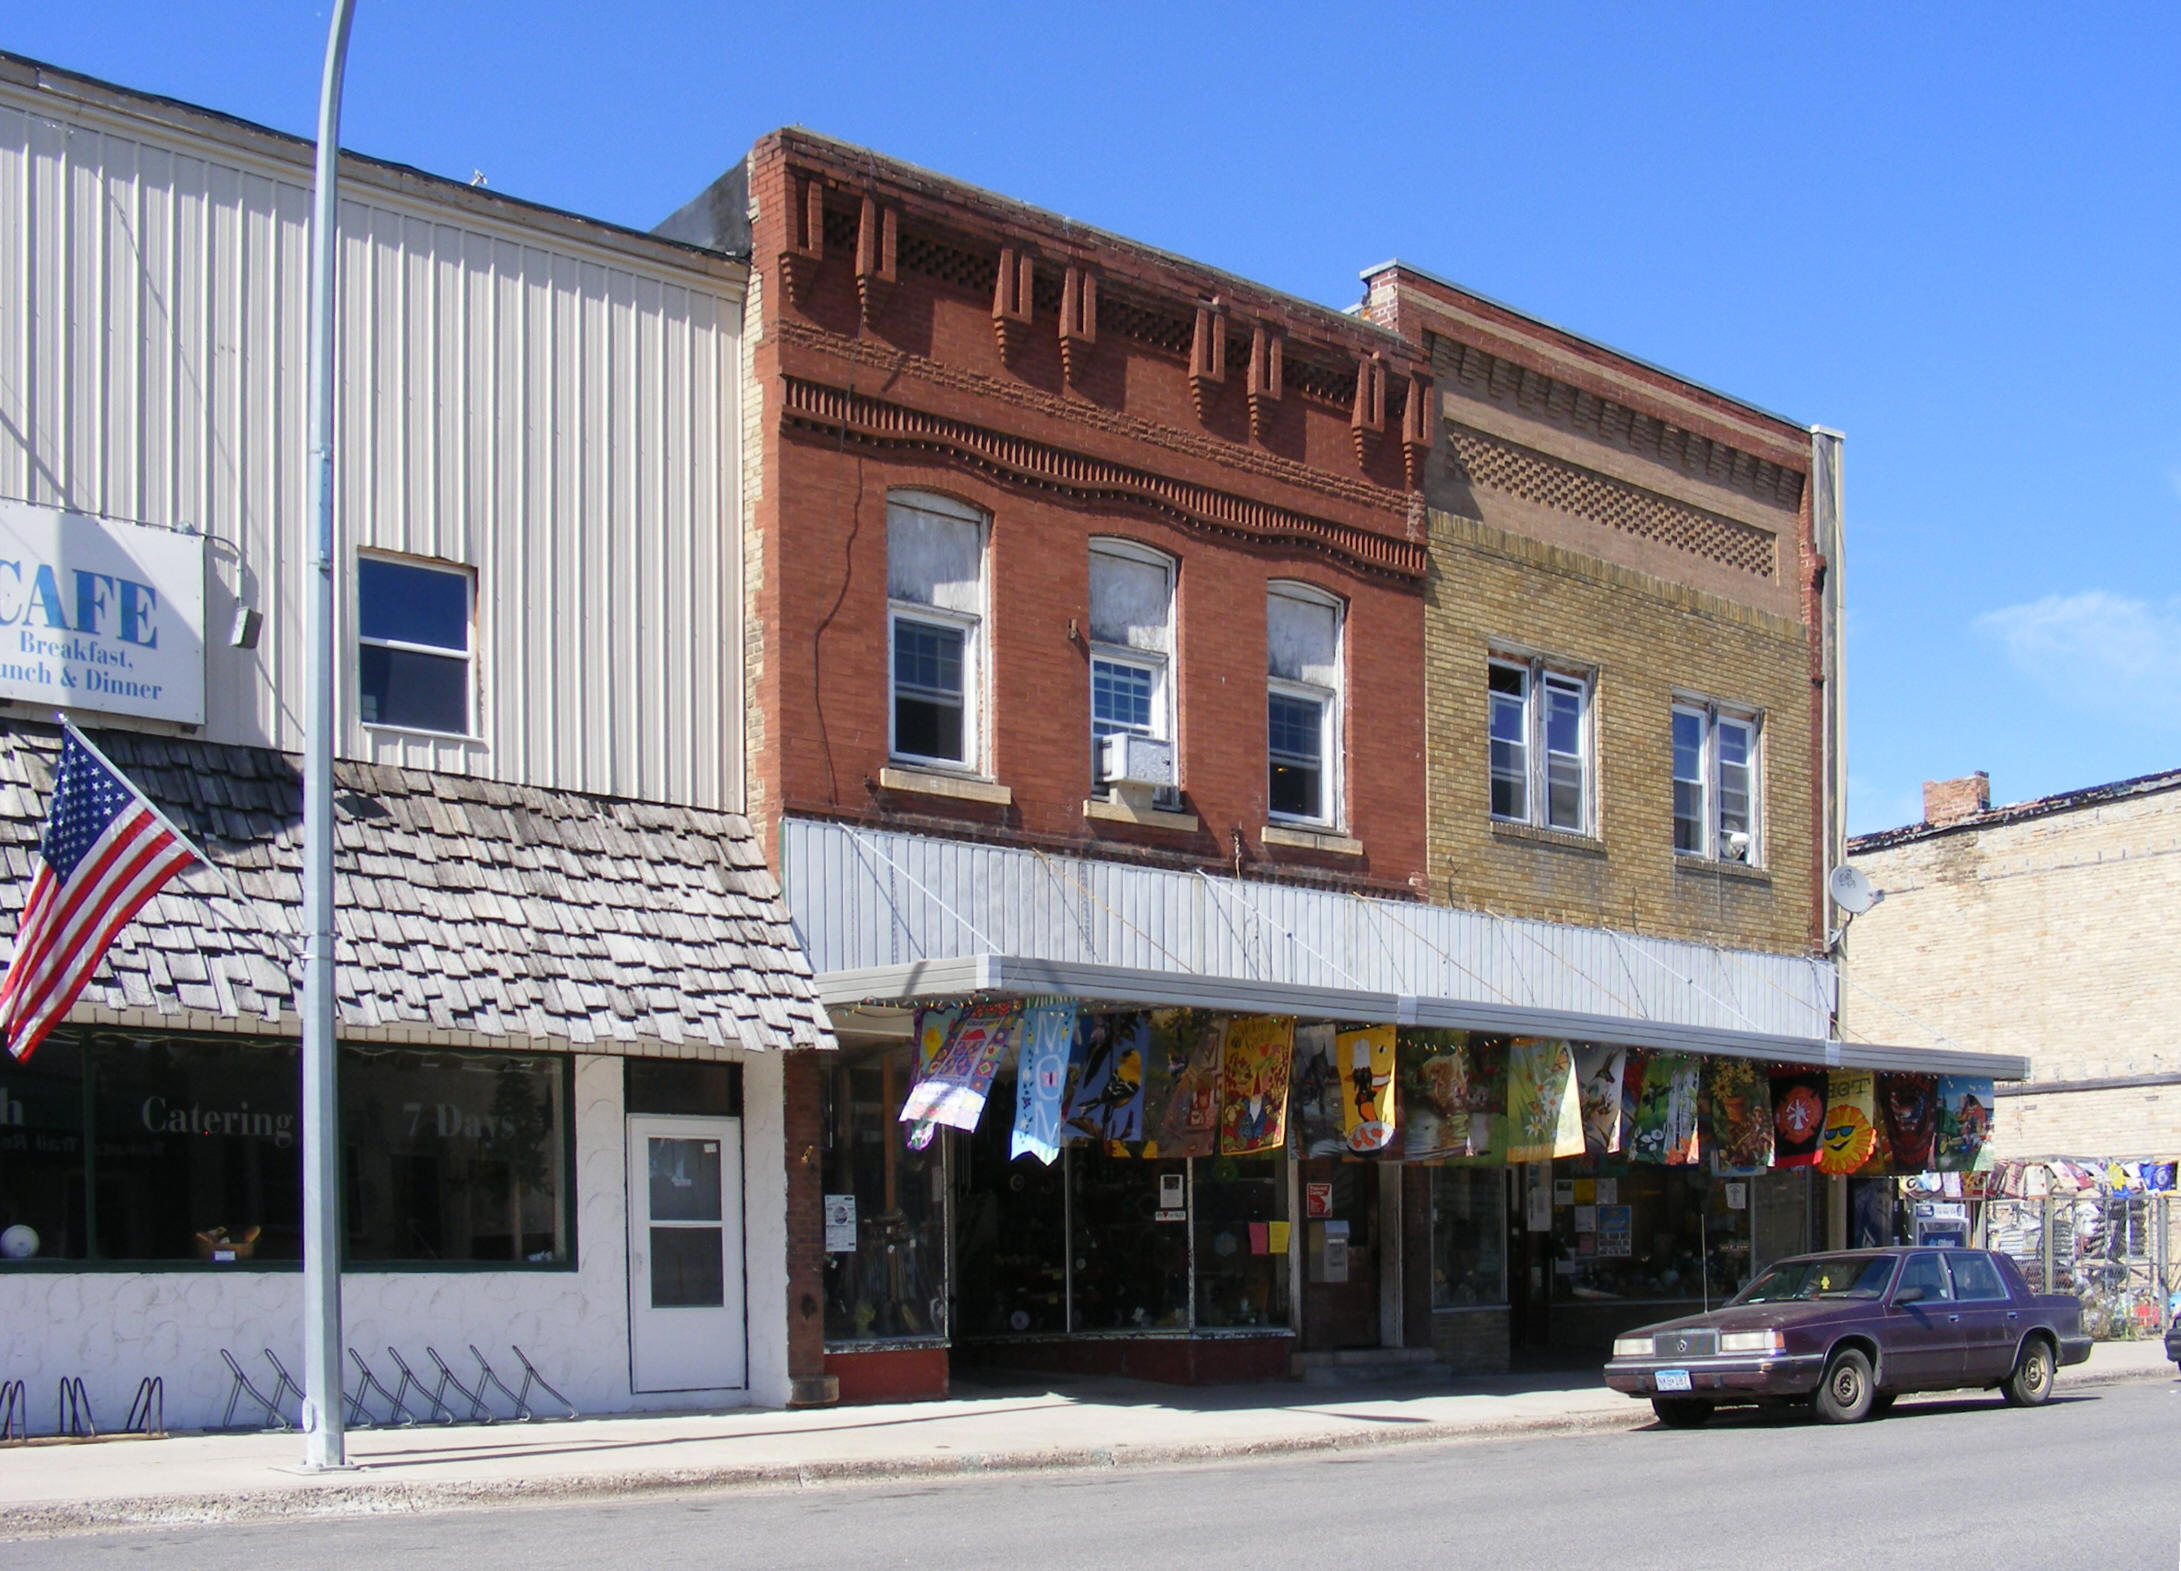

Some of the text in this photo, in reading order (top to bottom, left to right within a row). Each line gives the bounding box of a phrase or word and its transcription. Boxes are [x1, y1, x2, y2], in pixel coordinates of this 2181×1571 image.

[0, 558, 158, 650] CAFE
[19, 630, 134, 671] Breakfast,
[60, 665, 78, 689] &
[85, 668, 163, 700] Dinner
[141, 1095, 295, 1150] Catering
[402, 1102, 518, 1149] 7 Days
